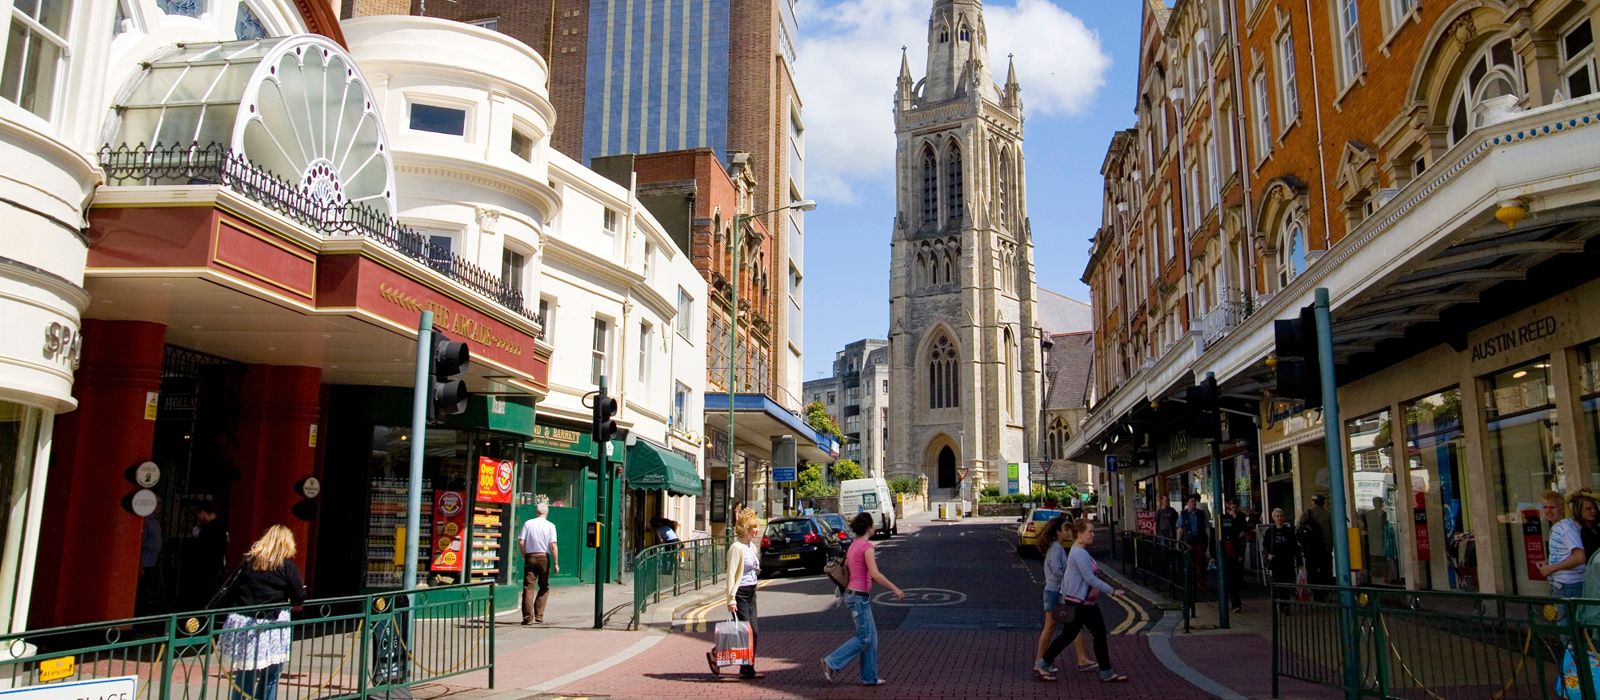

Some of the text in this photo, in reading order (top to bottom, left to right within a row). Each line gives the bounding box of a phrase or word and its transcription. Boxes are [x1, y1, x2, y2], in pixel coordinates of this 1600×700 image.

[427, 301, 492, 347] THE ARCADE
[1472, 316, 1556, 363] AUSTIN REED
[553, 427, 581, 442] BARRETT
[480, 463, 495, 475] Over
[480, 474, 494, 487] 800
[717, 651, 737, 660] sale
